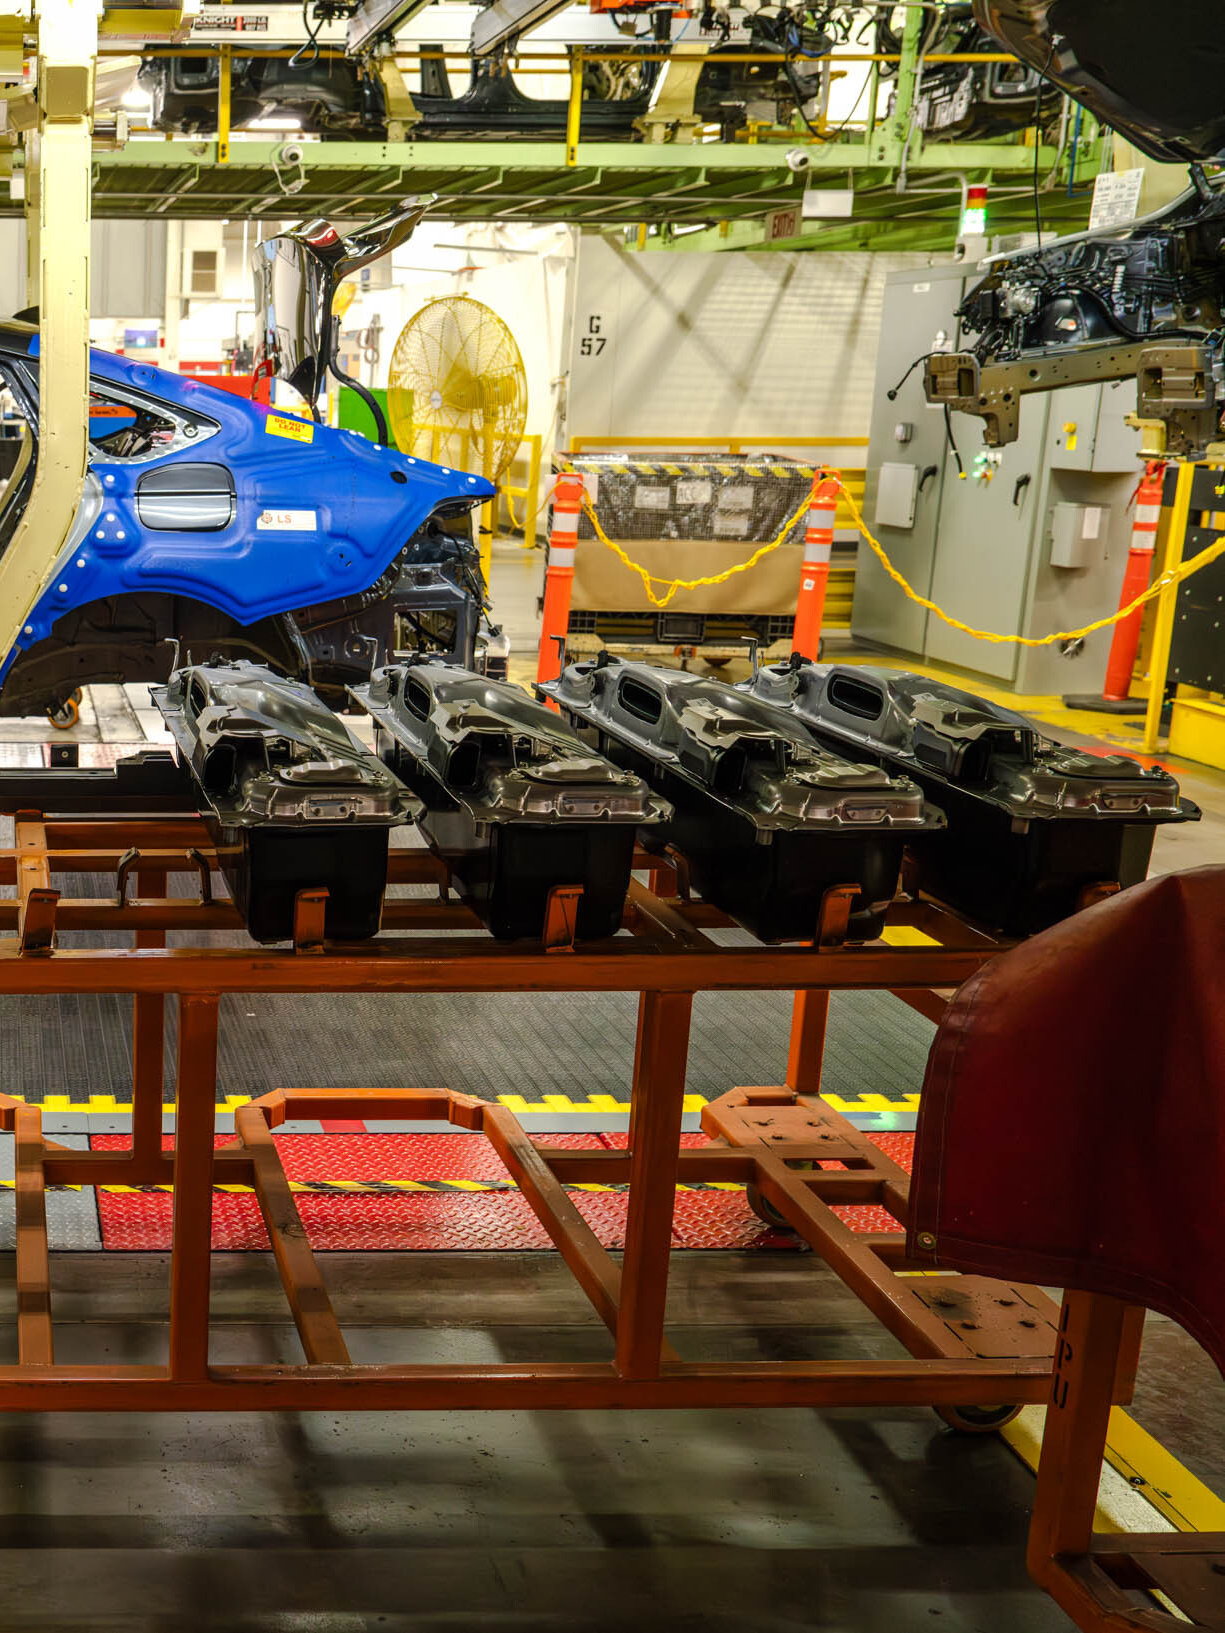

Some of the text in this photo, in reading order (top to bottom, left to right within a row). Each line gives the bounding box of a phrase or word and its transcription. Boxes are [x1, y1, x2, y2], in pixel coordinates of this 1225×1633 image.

[589, 315, 601, 334] G
[580, 337, 607, 356] 57
[274, 417, 306, 430] DO NOT
[278, 423, 301, 433] LEAN
[277, 514, 292, 524] LS
